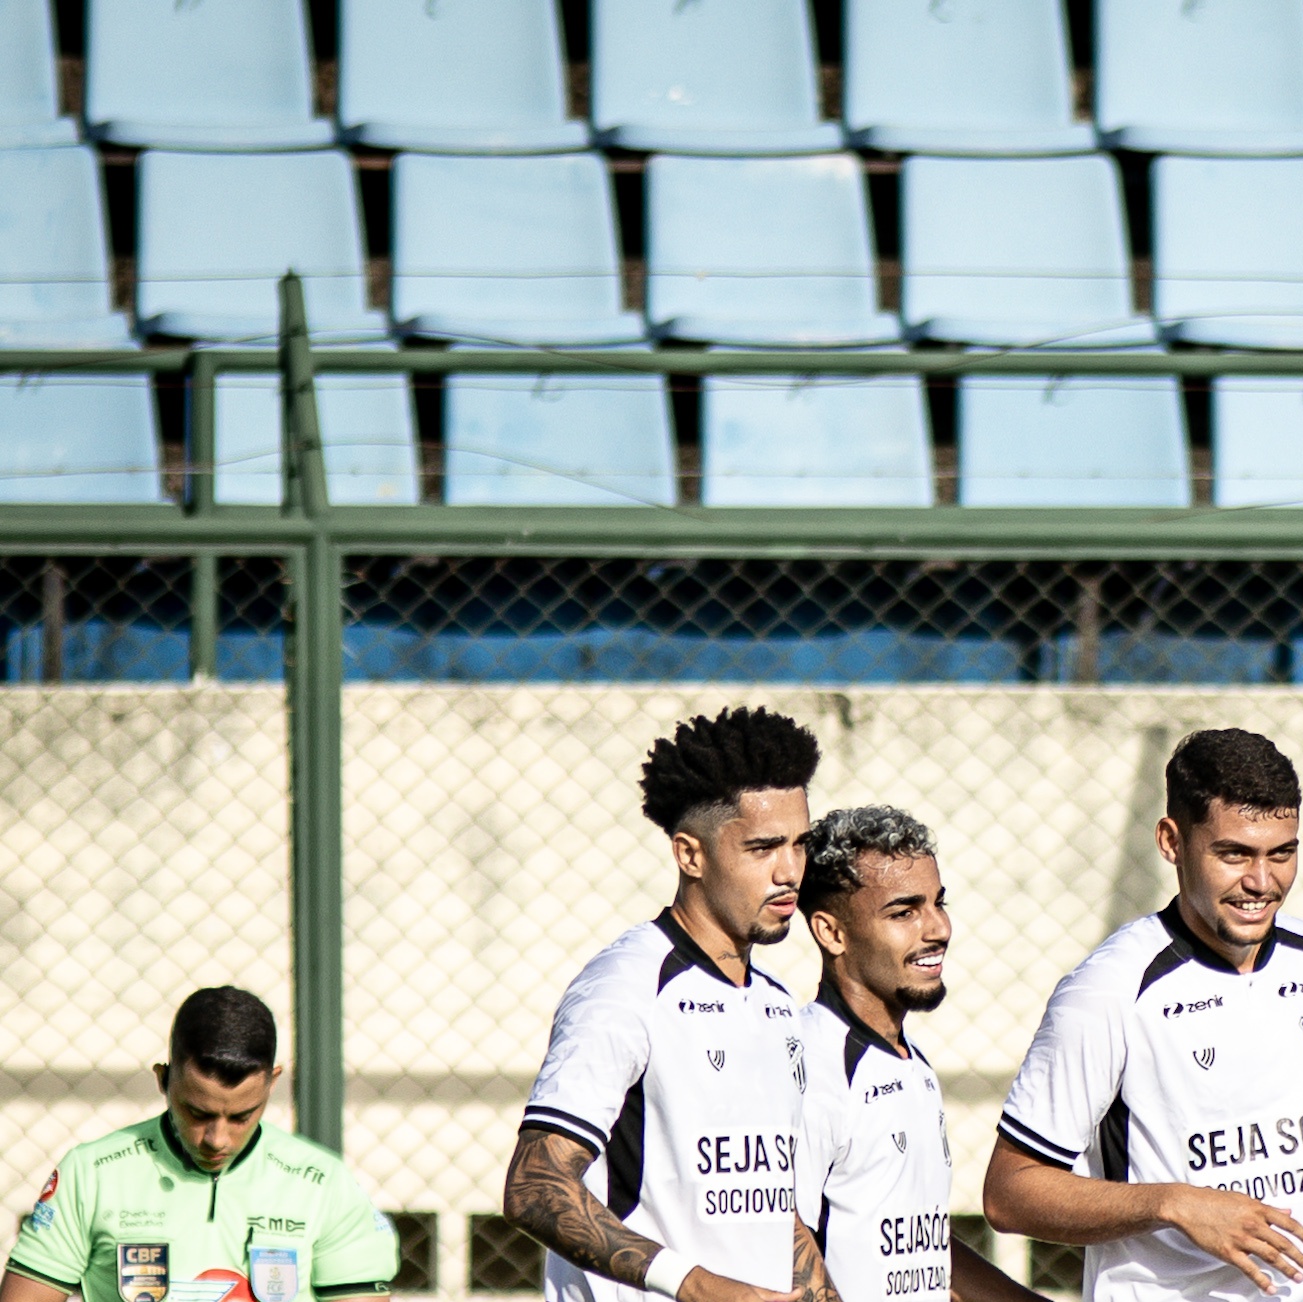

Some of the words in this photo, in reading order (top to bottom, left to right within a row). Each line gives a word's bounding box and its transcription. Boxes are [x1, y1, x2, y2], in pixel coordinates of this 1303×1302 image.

[697, 1134, 771, 1175] SEJA
[1188, 1123, 1269, 1172] SEJA
[126, 1247, 162, 1264] CBF
[881, 1214, 925, 1256] SEJA
